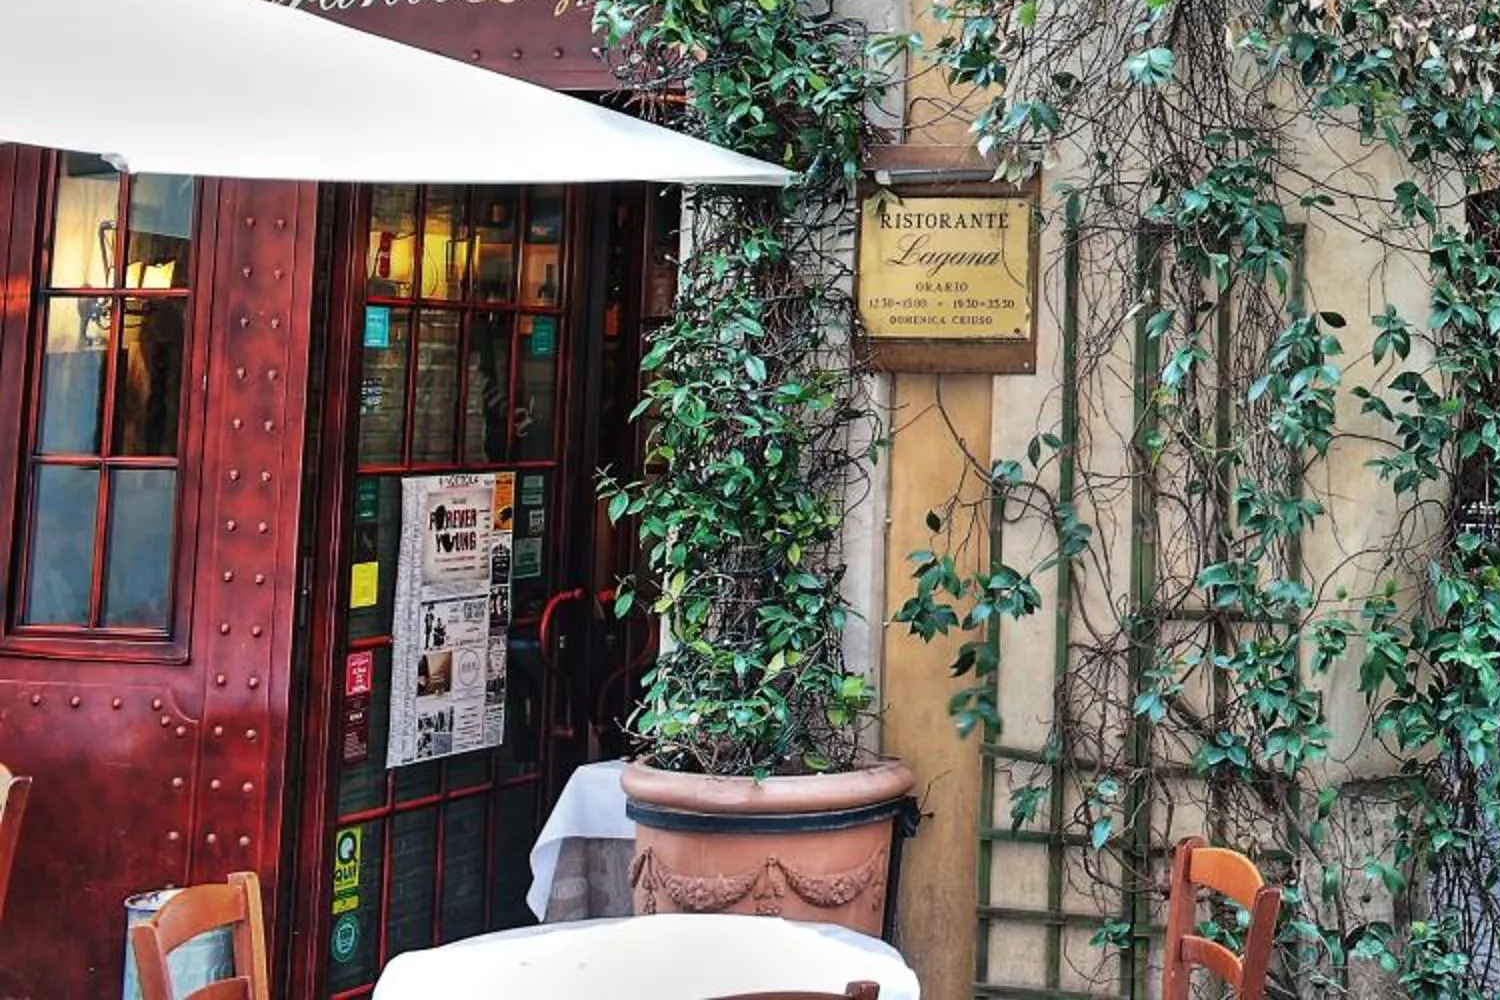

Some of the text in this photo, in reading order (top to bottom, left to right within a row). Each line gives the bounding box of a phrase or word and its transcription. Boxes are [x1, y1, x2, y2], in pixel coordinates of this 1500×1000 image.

[880, 212, 1010, 230] RISTORANTE
[914, 281, 969, 293] ORARIO
[889, 315, 947, 325] DOMENICA
